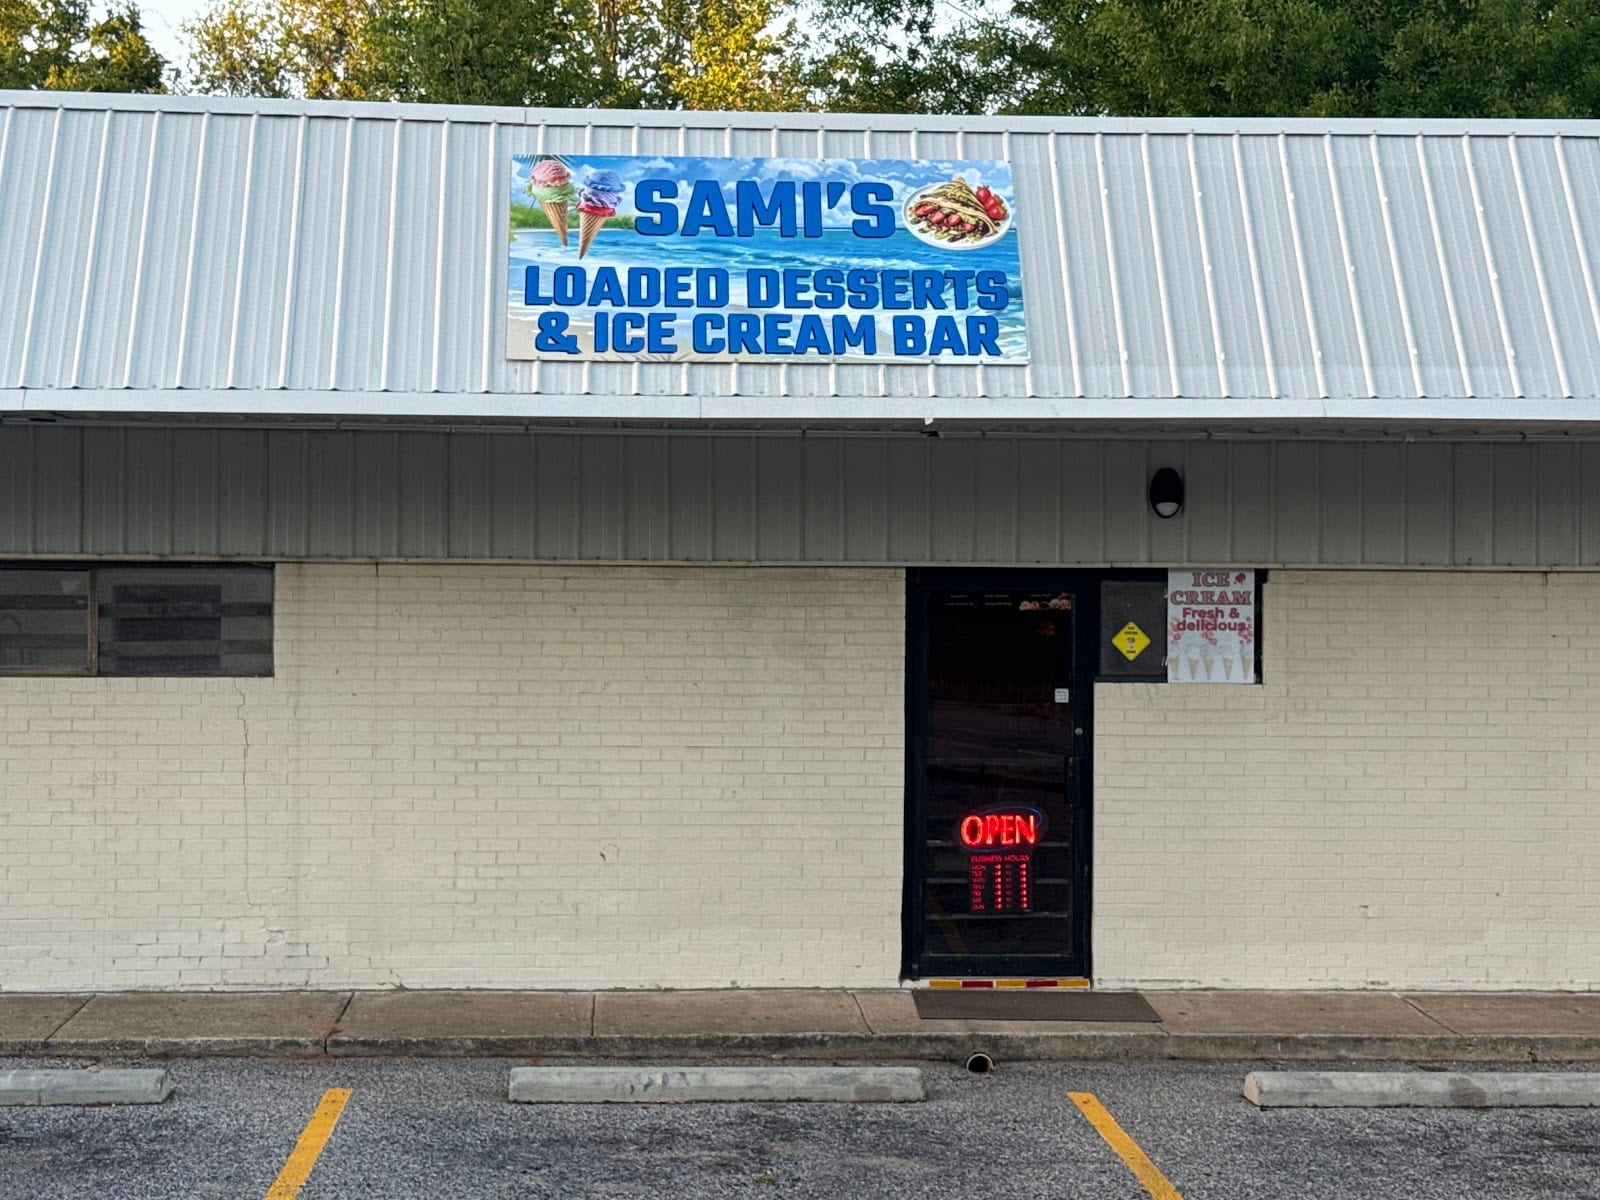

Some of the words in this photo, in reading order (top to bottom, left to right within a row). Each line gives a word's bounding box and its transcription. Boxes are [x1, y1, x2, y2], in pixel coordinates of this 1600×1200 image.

[634, 179, 896, 238] SAMI'S
[525, 266, 729, 307] LOADED
[746, 270, 1009, 311] DESSERTS
[535, 311, 582, 355] &
[594, 312, 677, 354] ICE
[691, 313, 878, 355] CREAM
[892, 315, 1002, 357] BAR
[1192, 572, 1230, 587] ICE
[1170, 590, 1252, 605] CREAM
[1182, 607, 1224, 618] Fresh
[1228, 607, 1240, 618] &
[961, 814, 1035, 845] OPEN
